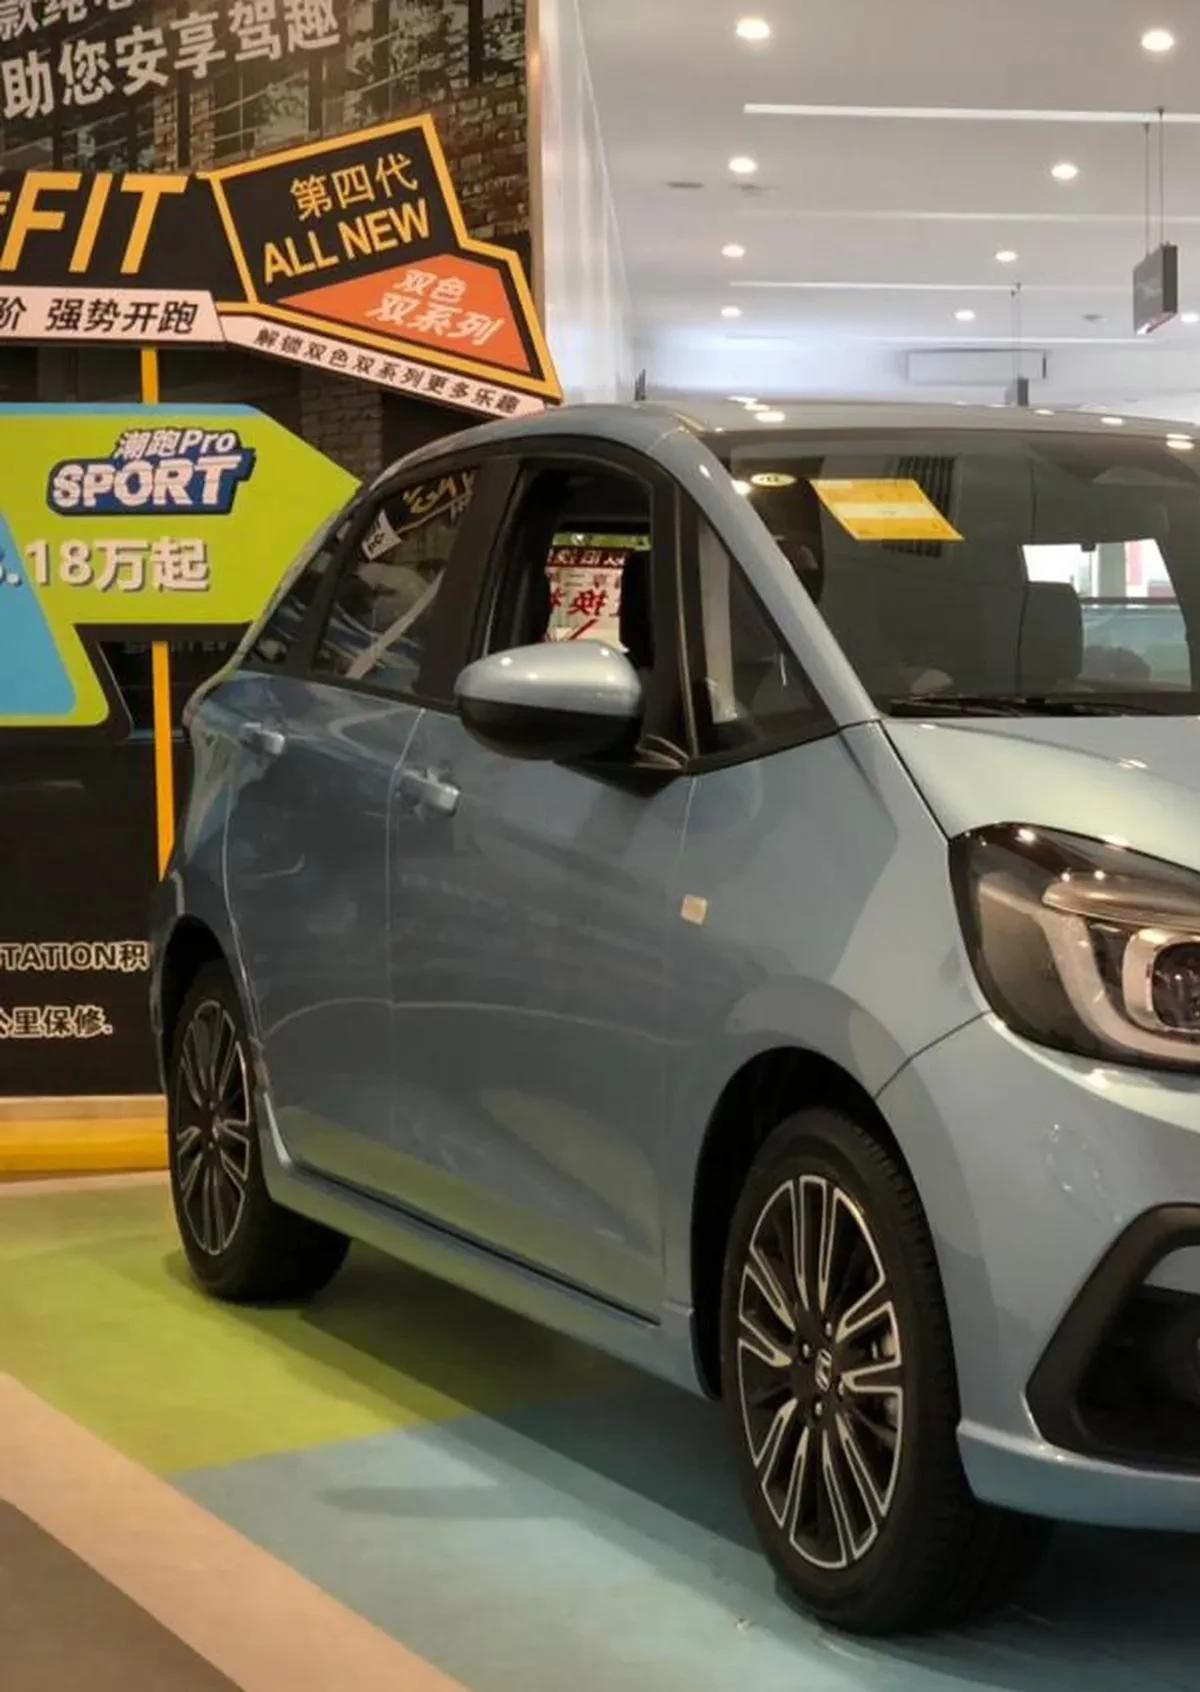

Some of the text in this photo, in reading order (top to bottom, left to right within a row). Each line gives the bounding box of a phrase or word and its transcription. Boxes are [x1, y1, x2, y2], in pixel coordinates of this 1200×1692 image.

[0, 0, 133, 41] 款纯
[2, 0, 341, 119] 助您安享驾趣
[289, 152, 418, 220] 第四代
[264, 198, 430, 284] ALL NEW
[393, 268, 467, 304] 双色
[45, 298, 199, 334] 强势开跑
[364, 291, 505, 346] 双系列
[253, 327, 521, 415] 解锁双色双系列更多乐趣
[52, 455, 242, 507] SPORT
[0, 536, 213, 593] .18万起
[0, 941, 149, 972] TATION积
